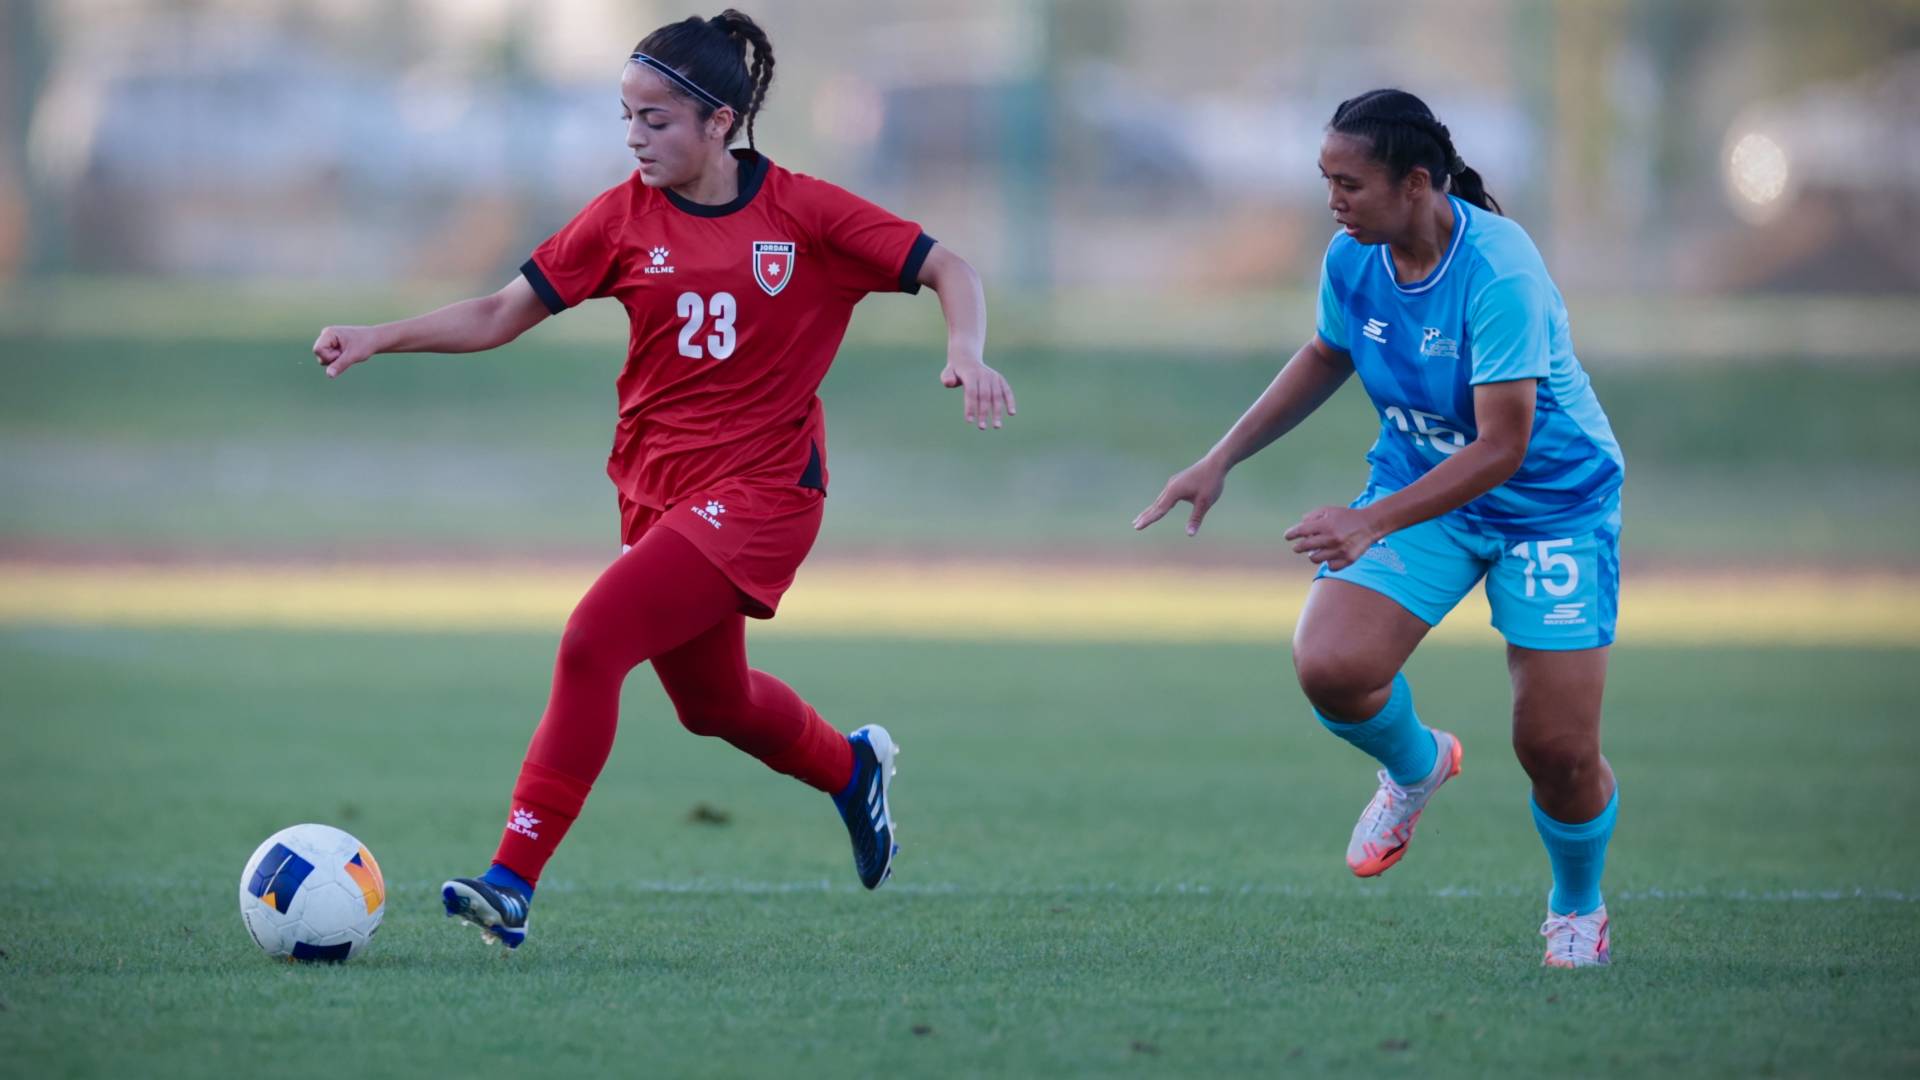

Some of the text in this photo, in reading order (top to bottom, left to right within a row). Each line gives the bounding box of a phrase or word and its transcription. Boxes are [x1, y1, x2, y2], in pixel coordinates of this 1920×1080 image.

[760, 244, 789, 252] JORDAN
[644, 266, 674, 274] KELME
[677, 292, 737, 360] 23
[1385, 406, 1465, 454] 15
[690, 506, 722, 530] KELME
[1511, 537, 1579, 597] 15
[506, 822, 539, 840] KELME
